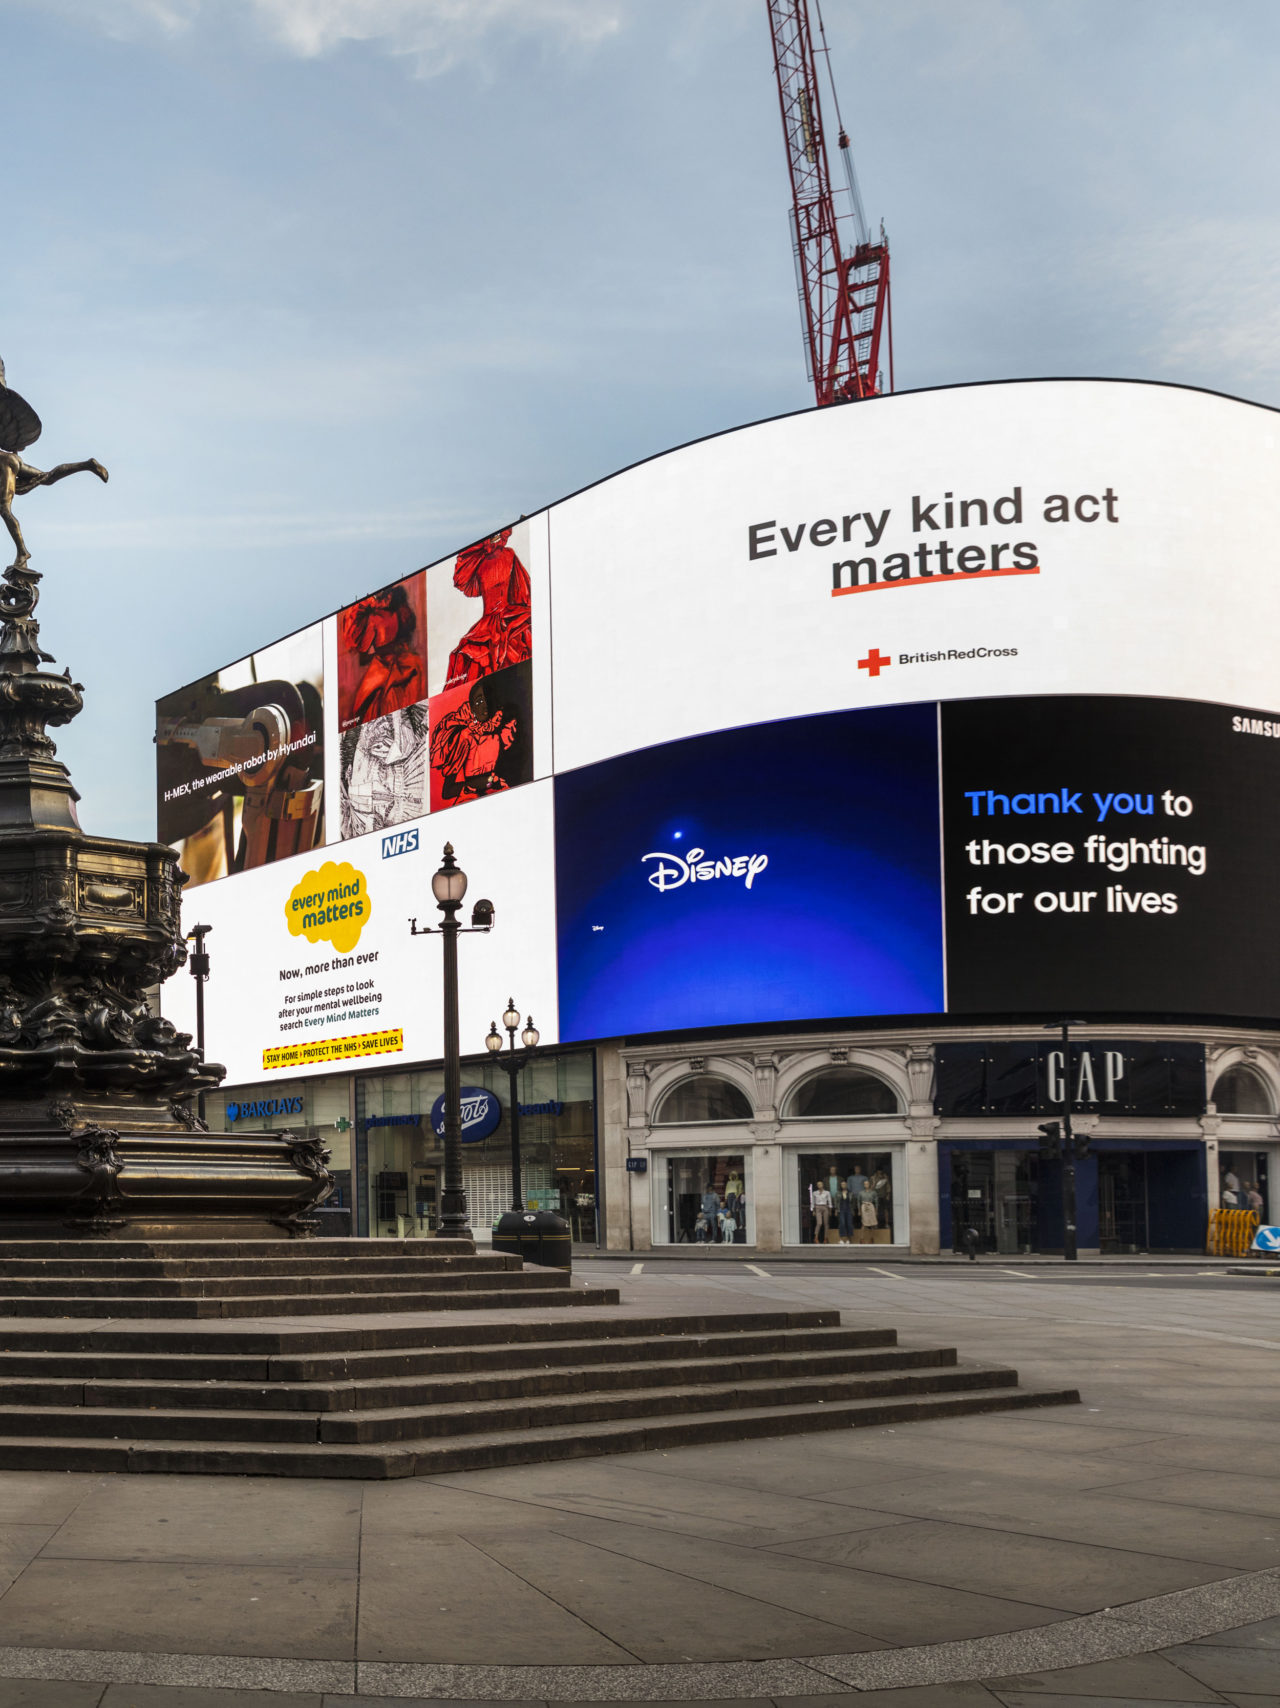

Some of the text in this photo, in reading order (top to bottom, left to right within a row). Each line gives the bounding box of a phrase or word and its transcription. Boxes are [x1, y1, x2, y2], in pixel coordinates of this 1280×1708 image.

[748, 486, 1119, 561] Every kind act
[832, 540, 1039, 589] matters
[898, 646, 1018, 665] BritishRedCross
[164, 731, 317, 801] H-MEX, the wearable robot by Hyundai
[964, 788, 1193, 822] Thank you to
[383, 830, 418, 858] NHS
[965, 835, 1207, 876] those fighting
[292, 878, 359, 911] every mind
[966, 884, 1179, 915] for our lives
[303, 900, 363, 928] matters
[279, 951, 379, 981] Now, more than ever
[278, 992, 382, 1018] after your mental wellbeing
[284, 979, 374, 1004] For simple steps to look
[280, 1007, 379, 1031] search Every Mind Matters
[266, 1036, 398, 1063] STAY HOME PROTECT THE NHS SAVE LIVES
[1048, 1051, 1124, 1103] GAP
[241, 1097, 303, 1118] BARCLAYS
[517, 1099, 564, 1116] beauty
[365, 1114, 421, 1130] pharmacy
